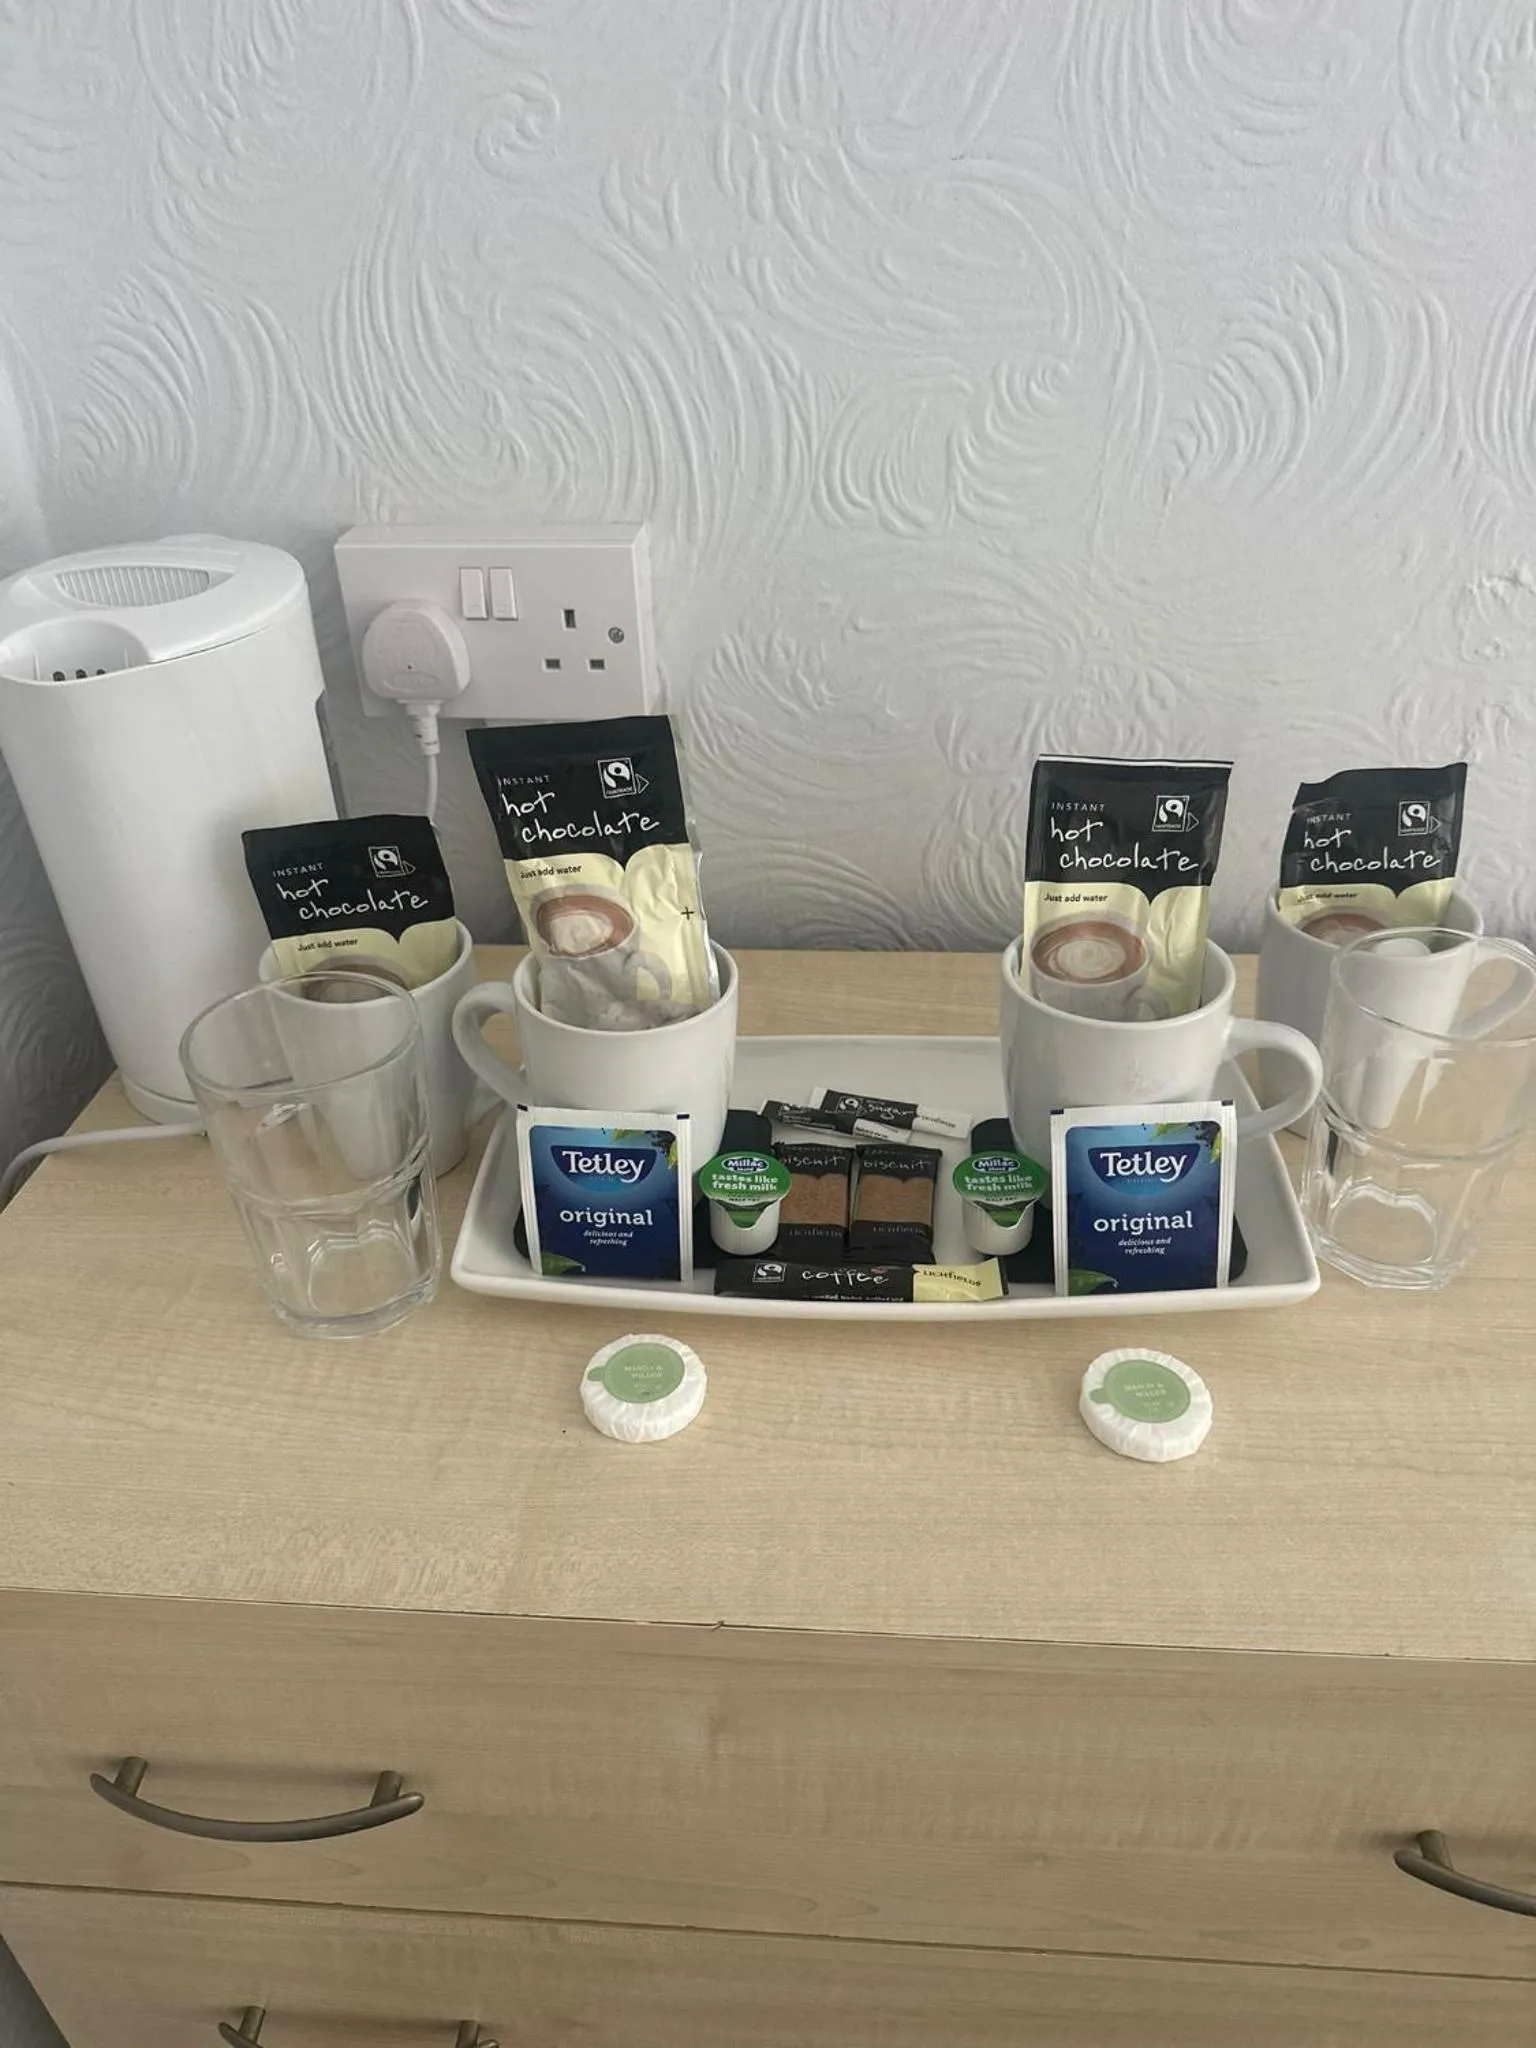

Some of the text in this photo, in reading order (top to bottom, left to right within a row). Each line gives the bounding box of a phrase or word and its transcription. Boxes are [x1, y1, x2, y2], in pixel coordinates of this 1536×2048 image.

[497, 775, 550, 787] INSTANT
[502, 790, 555, 817] hot
[1051, 802, 1106, 812] INSTANT
[1307, 813, 1352, 824] INSTANT
[522, 810, 660, 843] chocolate
[1051, 817, 1104, 842] hot
[1304, 828, 1352, 849] hot
[1060, 842, 1199, 871] chocolate
[1310, 846, 1441, 873] chocolate
[272, 862, 324, 878] INSTANT
[537, 867, 554, 876] add
[556, 864, 582, 875] water
[276, 879, 329, 901] hot
[1044, 893, 1063, 902] Just
[1065, 894, 1081, 902] add
[300, 888, 428, 920] chocolate
[298, 938, 358, 951] Just add water
[867, 1104, 914, 1120] sugar
[562, 1151, 646, 1184] Tetley
[728, 1158, 764, 1168] Millac
[863, 1160, 932, 1170] biscuit
[978, 1158, 1015, 1168] Millac
[1100, 1151, 1188, 1182] Tetley
[712, 1174, 778, 1184] tastes like
[964, 1174, 1033, 1184] tastes like
[712, 1181, 777, 1191] fresh milk
[966, 1181, 1033, 1191] fresh milk
[560, 1207, 653, 1227] original
[1093, 1211, 1193, 1235] original
[583, 1230, 617, 1238] delicious
[589, 1238, 628, 1247] refreshing
[1118, 1237, 1171, 1247] delicious and
[1125, 1247, 1165, 1256] refreshing
[802, 1267, 891, 1287] coffee
